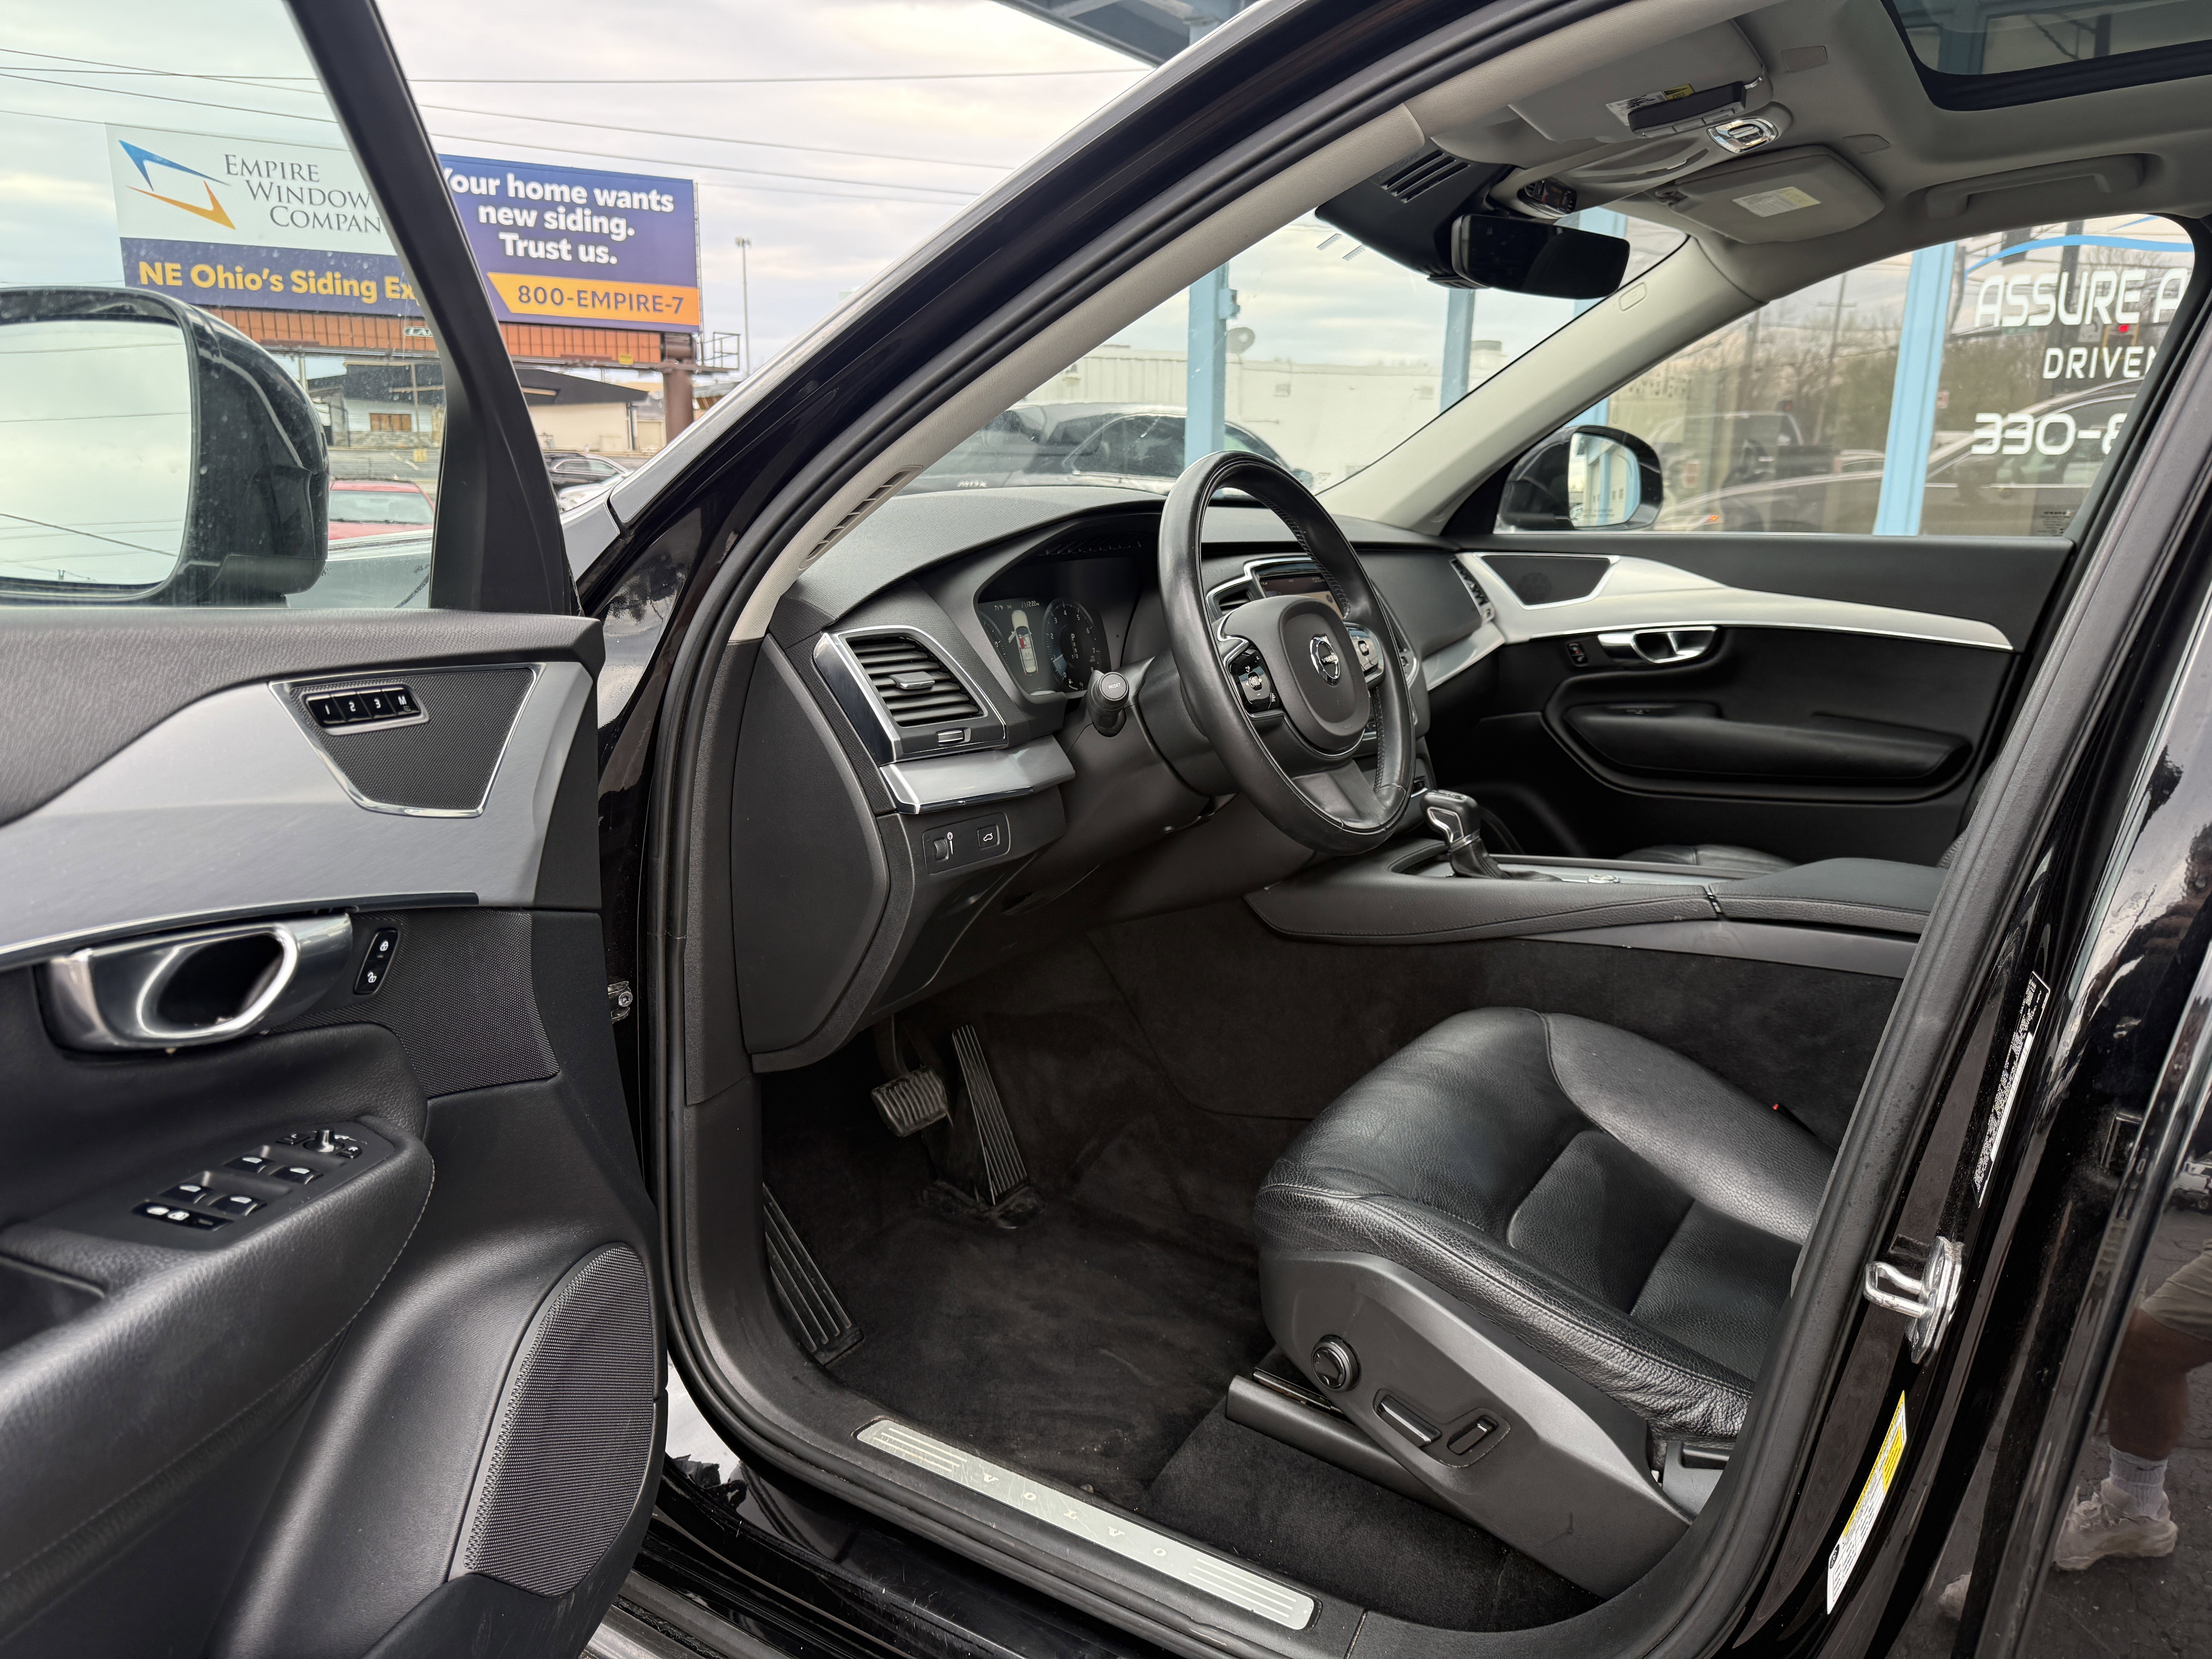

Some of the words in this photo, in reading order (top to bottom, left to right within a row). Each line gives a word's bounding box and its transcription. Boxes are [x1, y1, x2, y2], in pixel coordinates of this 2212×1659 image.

[224, 154, 319, 182] EMPIRE
[245, 180, 371, 209] WINDOW
[507, 173, 587, 204] home
[594, 187, 674, 212] wants
[479, 205, 538, 227] new
[544, 206, 635, 241] siding.
[499, 232, 572, 261] Trust
[578, 244, 618, 264] us.
[139, 261, 182, 286] NE
[190, 264, 283, 292] Ohio's
[290, 270, 377, 303] Siding
[385, 276, 420, 306] Ex
[1974, 268, 2146, 327] ASSURE
[518, 285, 684, 315] 800-EMPIRE-7
[325, 704, 330, 714] 1
[349, 701, 356, 712] 2
[374, 698, 381, 708] 3
[398, 696, 406, 705] M
[983, 1473, 1166, 1556] VOLVO
